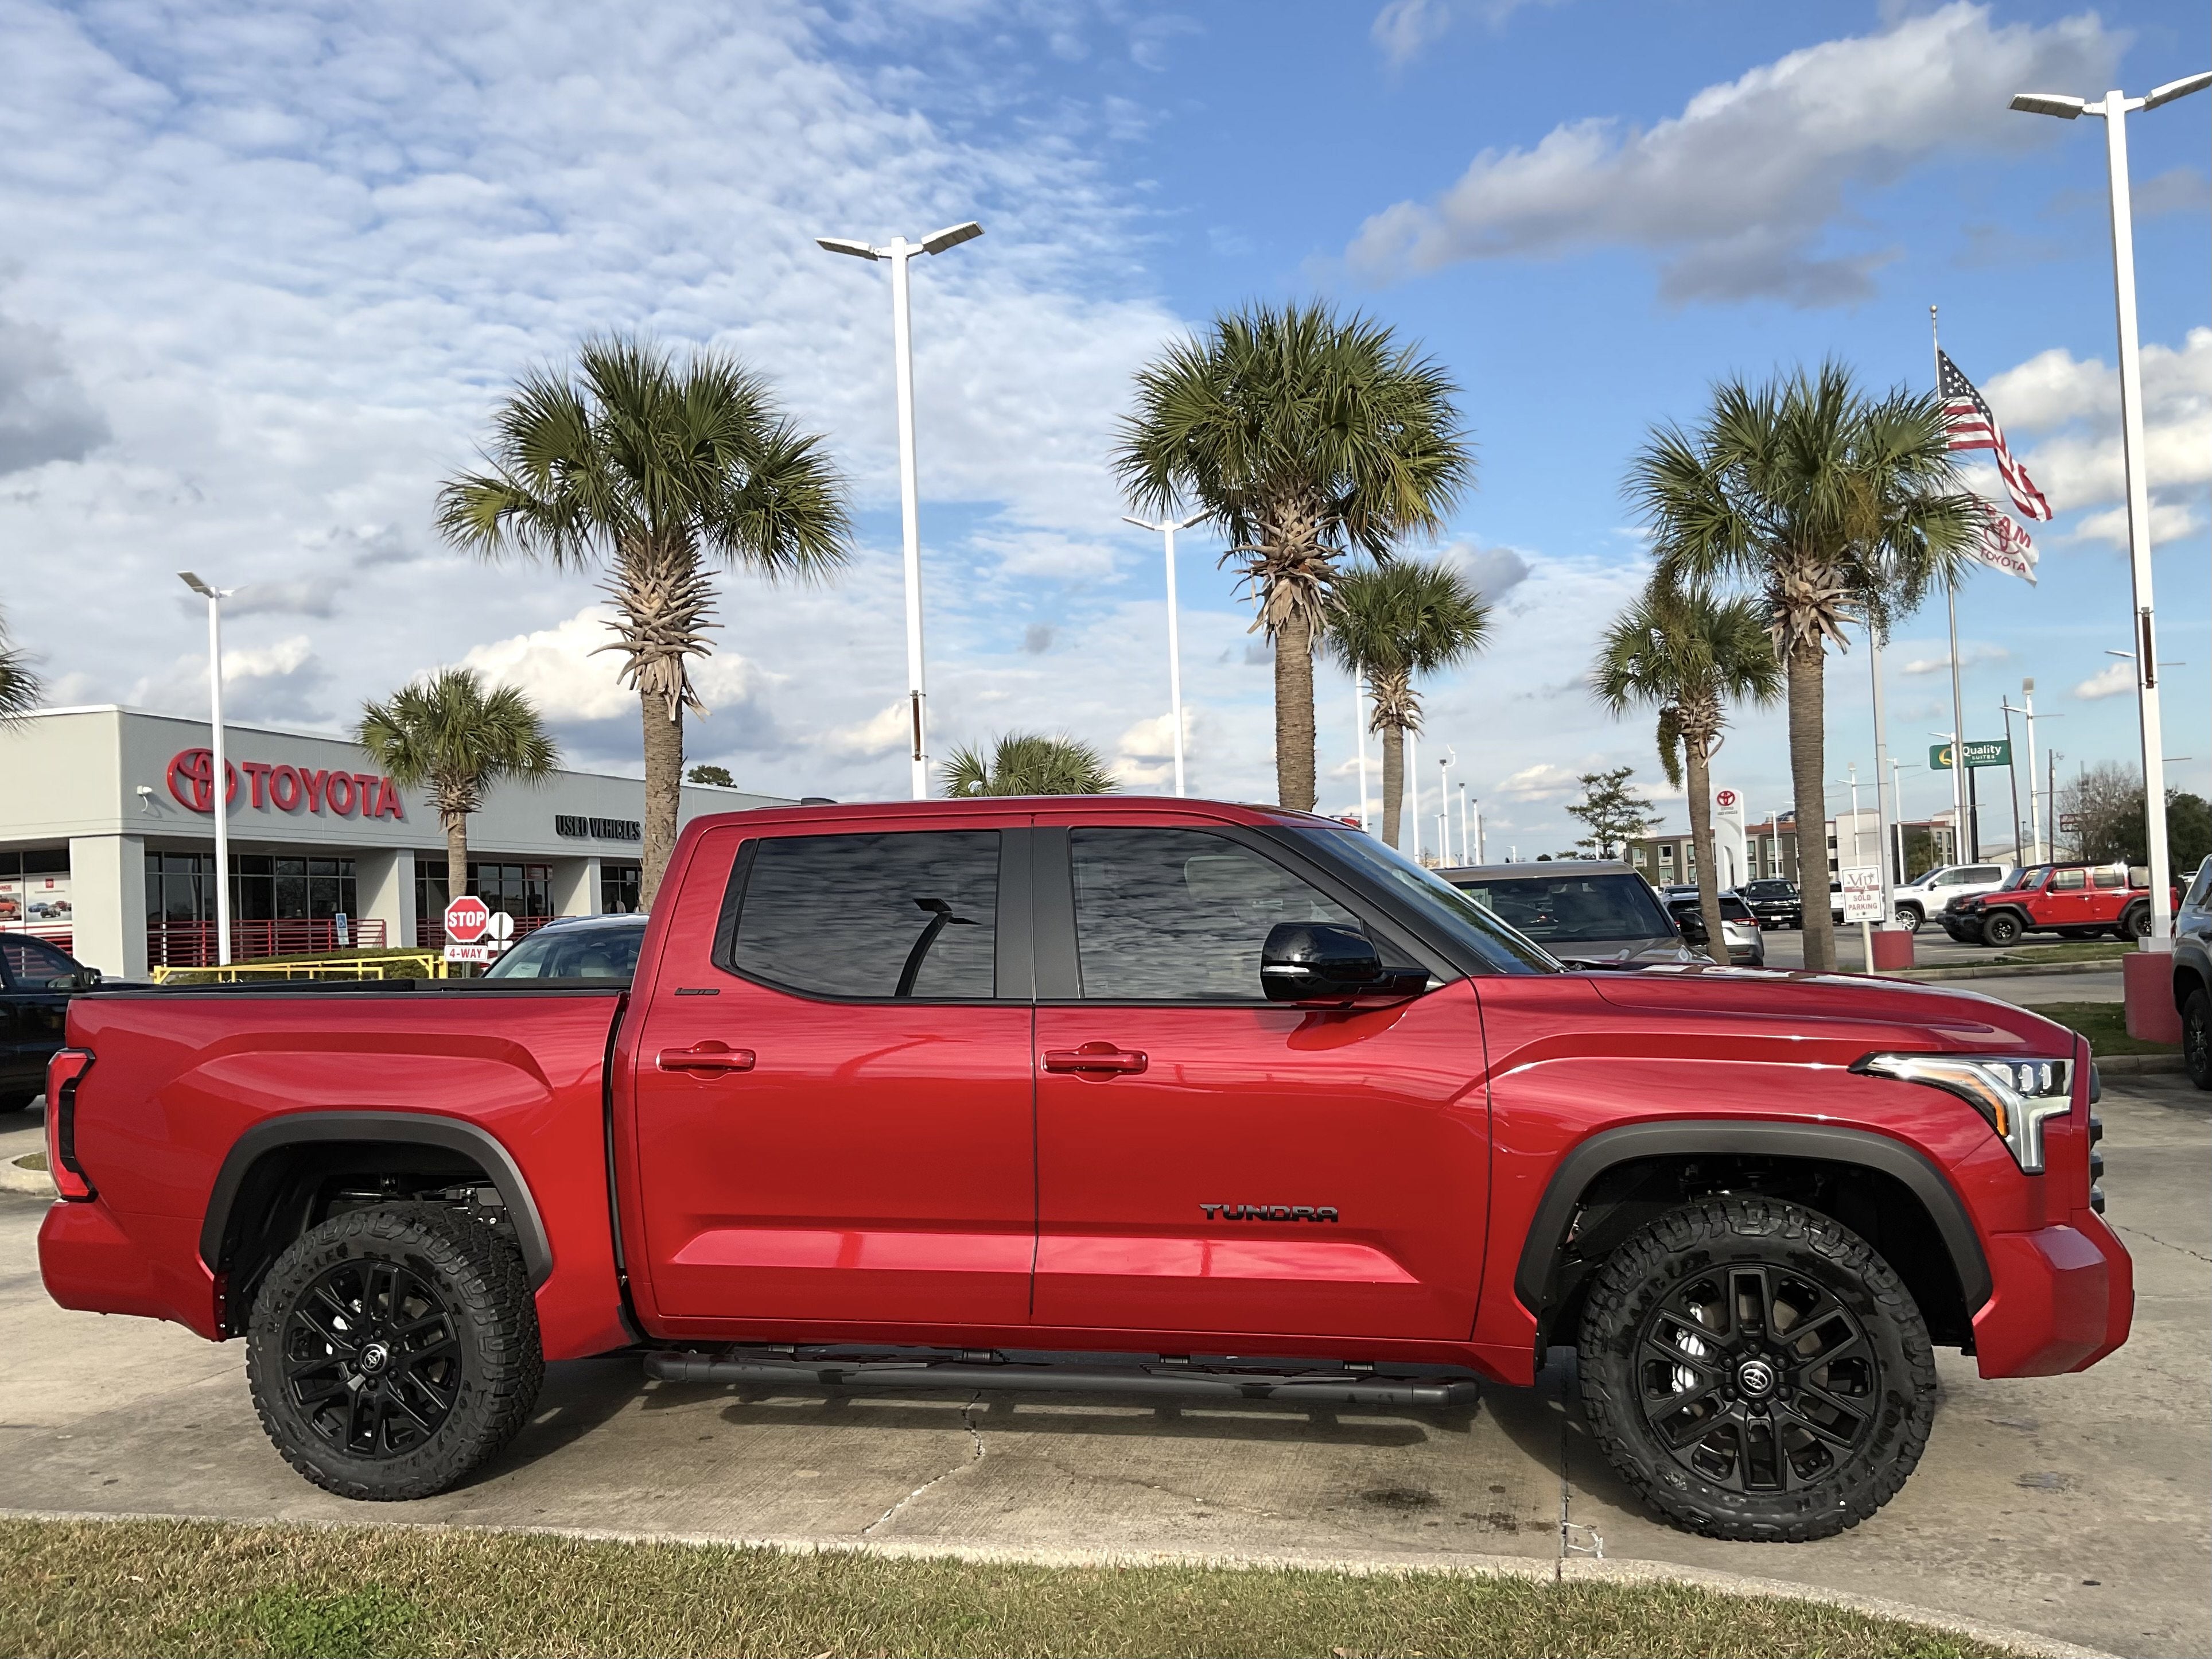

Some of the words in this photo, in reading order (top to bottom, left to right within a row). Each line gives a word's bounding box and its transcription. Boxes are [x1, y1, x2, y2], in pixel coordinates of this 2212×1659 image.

[1980, 546, 2026, 573] TOYOTA
[1962, 744, 2001, 757] Quality
[242, 761, 404, 818] TOYOTA
[555, 815, 589, 837] USED
[589, 818, 641, 841] VEHICLES
[1848, 903, 1877, 911] PARKING
[448, 911, 485, 927] STOP
[449, 948, 483, 958] 4-WAY
[1199, 1204, 1338, 1222] TUNDRA
